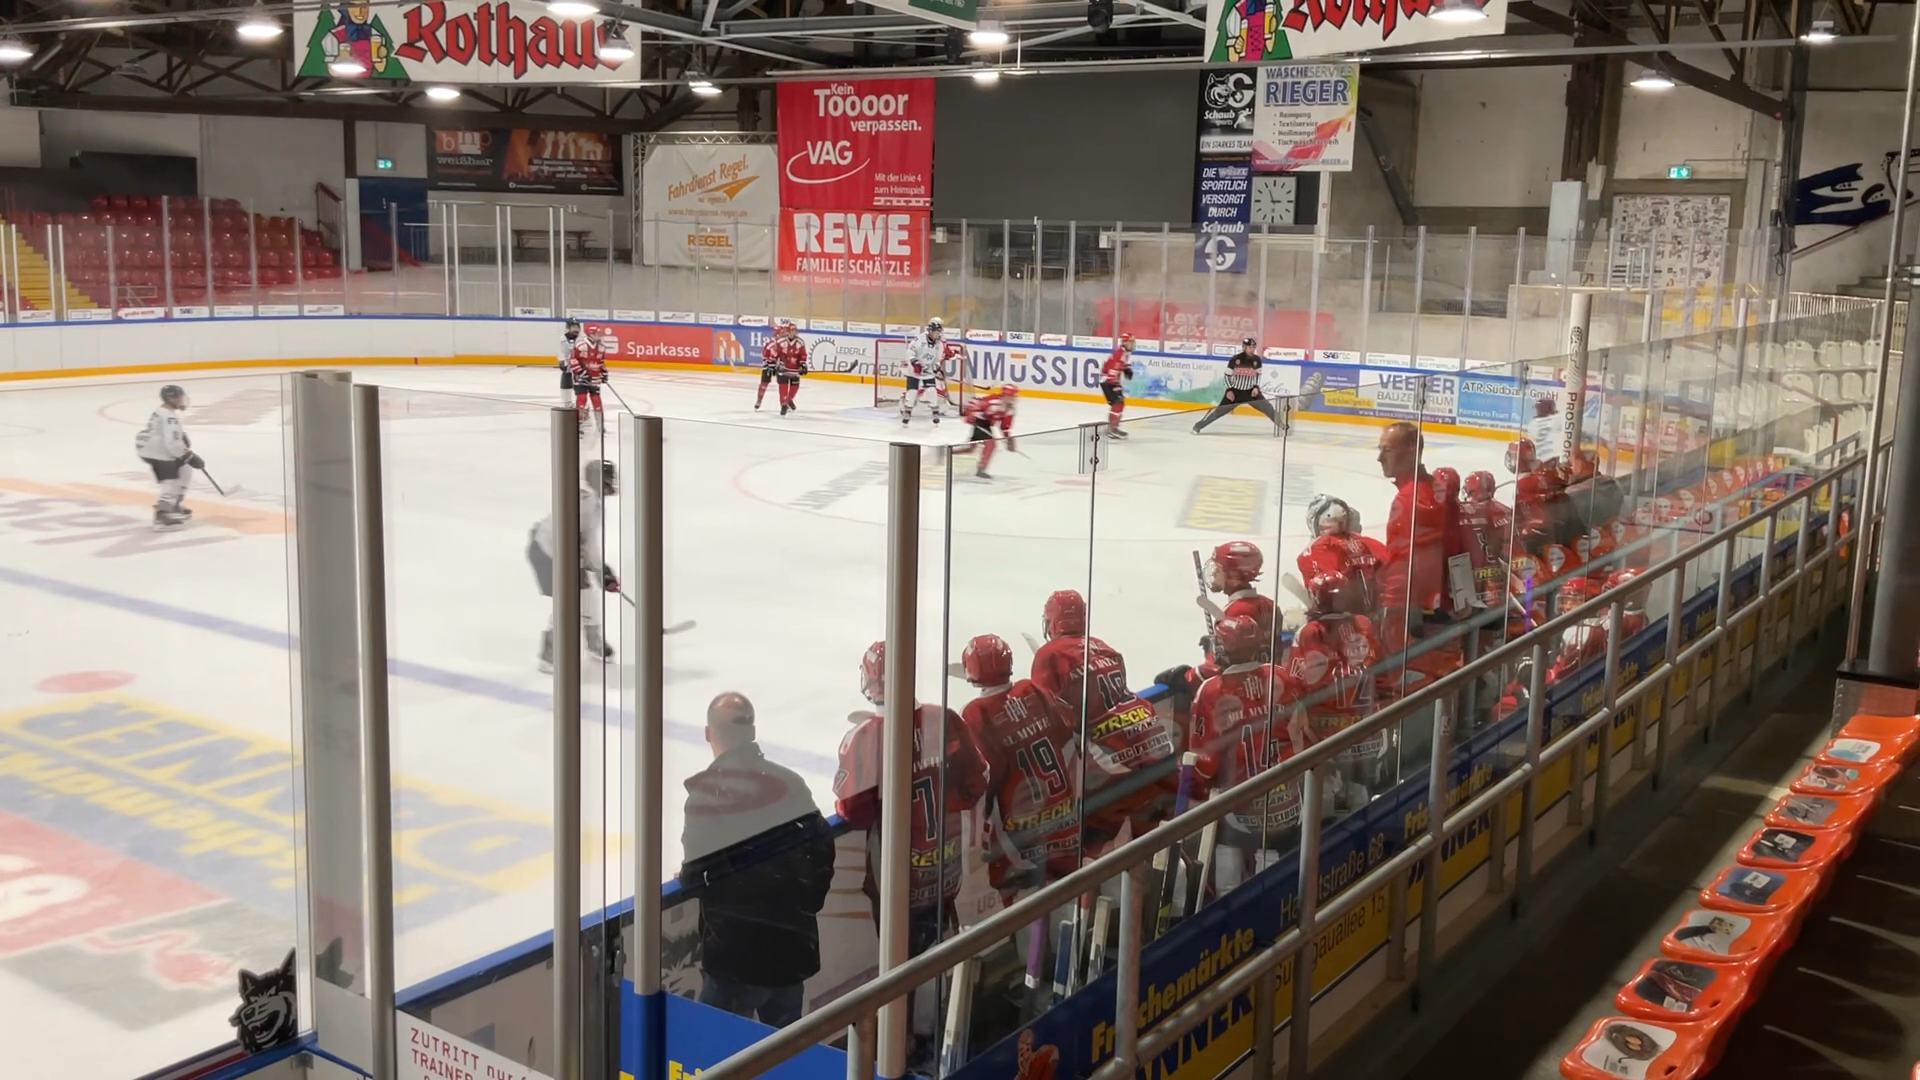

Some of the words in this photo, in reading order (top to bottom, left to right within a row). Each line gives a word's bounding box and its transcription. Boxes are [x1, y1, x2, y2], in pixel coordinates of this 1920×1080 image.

[831, 83, 854, 95] Kein
[1265, 79, 1349, 106] RIEGER
[814, 89, 908, 117] Toooor
[1204, 110, 1235, 119] Schaub
[851, 119, 922, 135] verpassen.
[807, 140, 853, 165] VAG
[668, 168, 717, 201] Fahrdienst
[720, 154, 749, 180] Regel.
[875, 173, 885, 182] Mit
[887, 173, 899, 182] der
[900, 173, 916, 182] Linie
[1203, 168, 1217, 178] DIE
[1201, 181, 1247, 191] SPORTLICH
[1202, 194, 1246, 204] VERSORGT
[1208, 208, 1237, 217] DURCH
[794, 213, 911, 256] REWE
[1201, 221, 1244, 233] Schaub
[688, 234, 733, 247] REGEL
[797, 258, 844, 273] FAMILIE
[1166, 312, 1253, 330] Lexare
[627, 342, 700, 358] Sparkasse
[836, 346, 867, 356] LEDERLE
[1148, 359, 1160, 367] Am
[1161, 359, 1191, 369] liebsten
[1379, 373, 1455, 395] VEEER
[1463, 382, 1483, 393] ATR
[1530, 388, 1559, 400] GmbH
[1377, 391, 1454, 407] BAUZERUM
[1560, 392, 1577, 464] PROSPOR
[1092, 706, 1152, 740] STRECK
[1016, 736, 1068, 804] 19
[1005, 796, 1074, 832] STRECK
[1280, 850, 1365, 928] Hatstraße
[1368, 832, 1385, 865] 68
[1371, 893, 1385, 917] 15
[1092, 927, 1255, 1065] Frchemärkte
[411, 1027, 479, 1070] ZUTRITT
